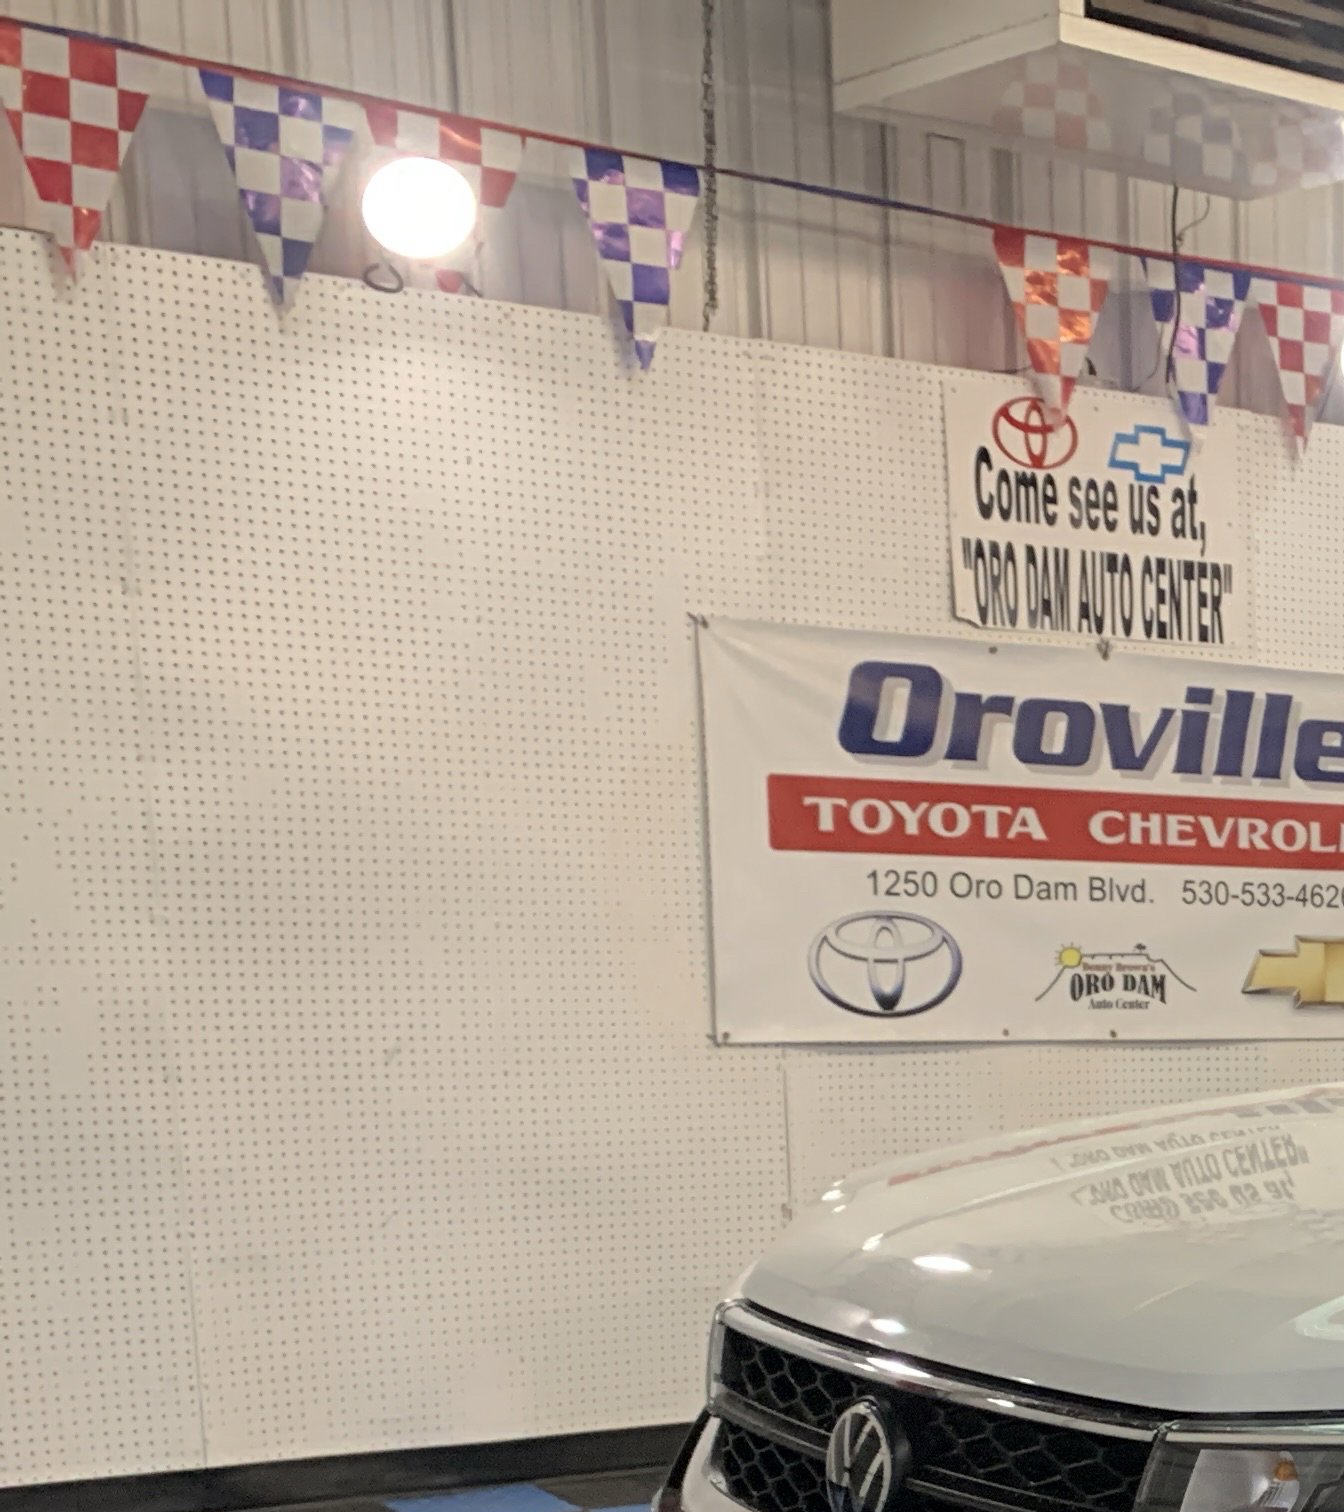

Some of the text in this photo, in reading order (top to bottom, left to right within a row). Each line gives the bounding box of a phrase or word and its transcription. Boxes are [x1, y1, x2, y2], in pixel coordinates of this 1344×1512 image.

[974, 446, 1207, 557] Come see us at,
[961, 537, 1233, 644] "ORO DAM AUTO CENTER"
[803, 796, 1048, 841] TOYOTA
[866, 868, 939, 899] 1250
[949, 872, 1002, 902] Oro
[1013, 873, 1079, 903] Dam
[1089, 876, 1155, 905] Blvd.
[1070, 972, 1167, 1005] ORO DAM
[1088, 998, 1150, 1010] Auto Center
